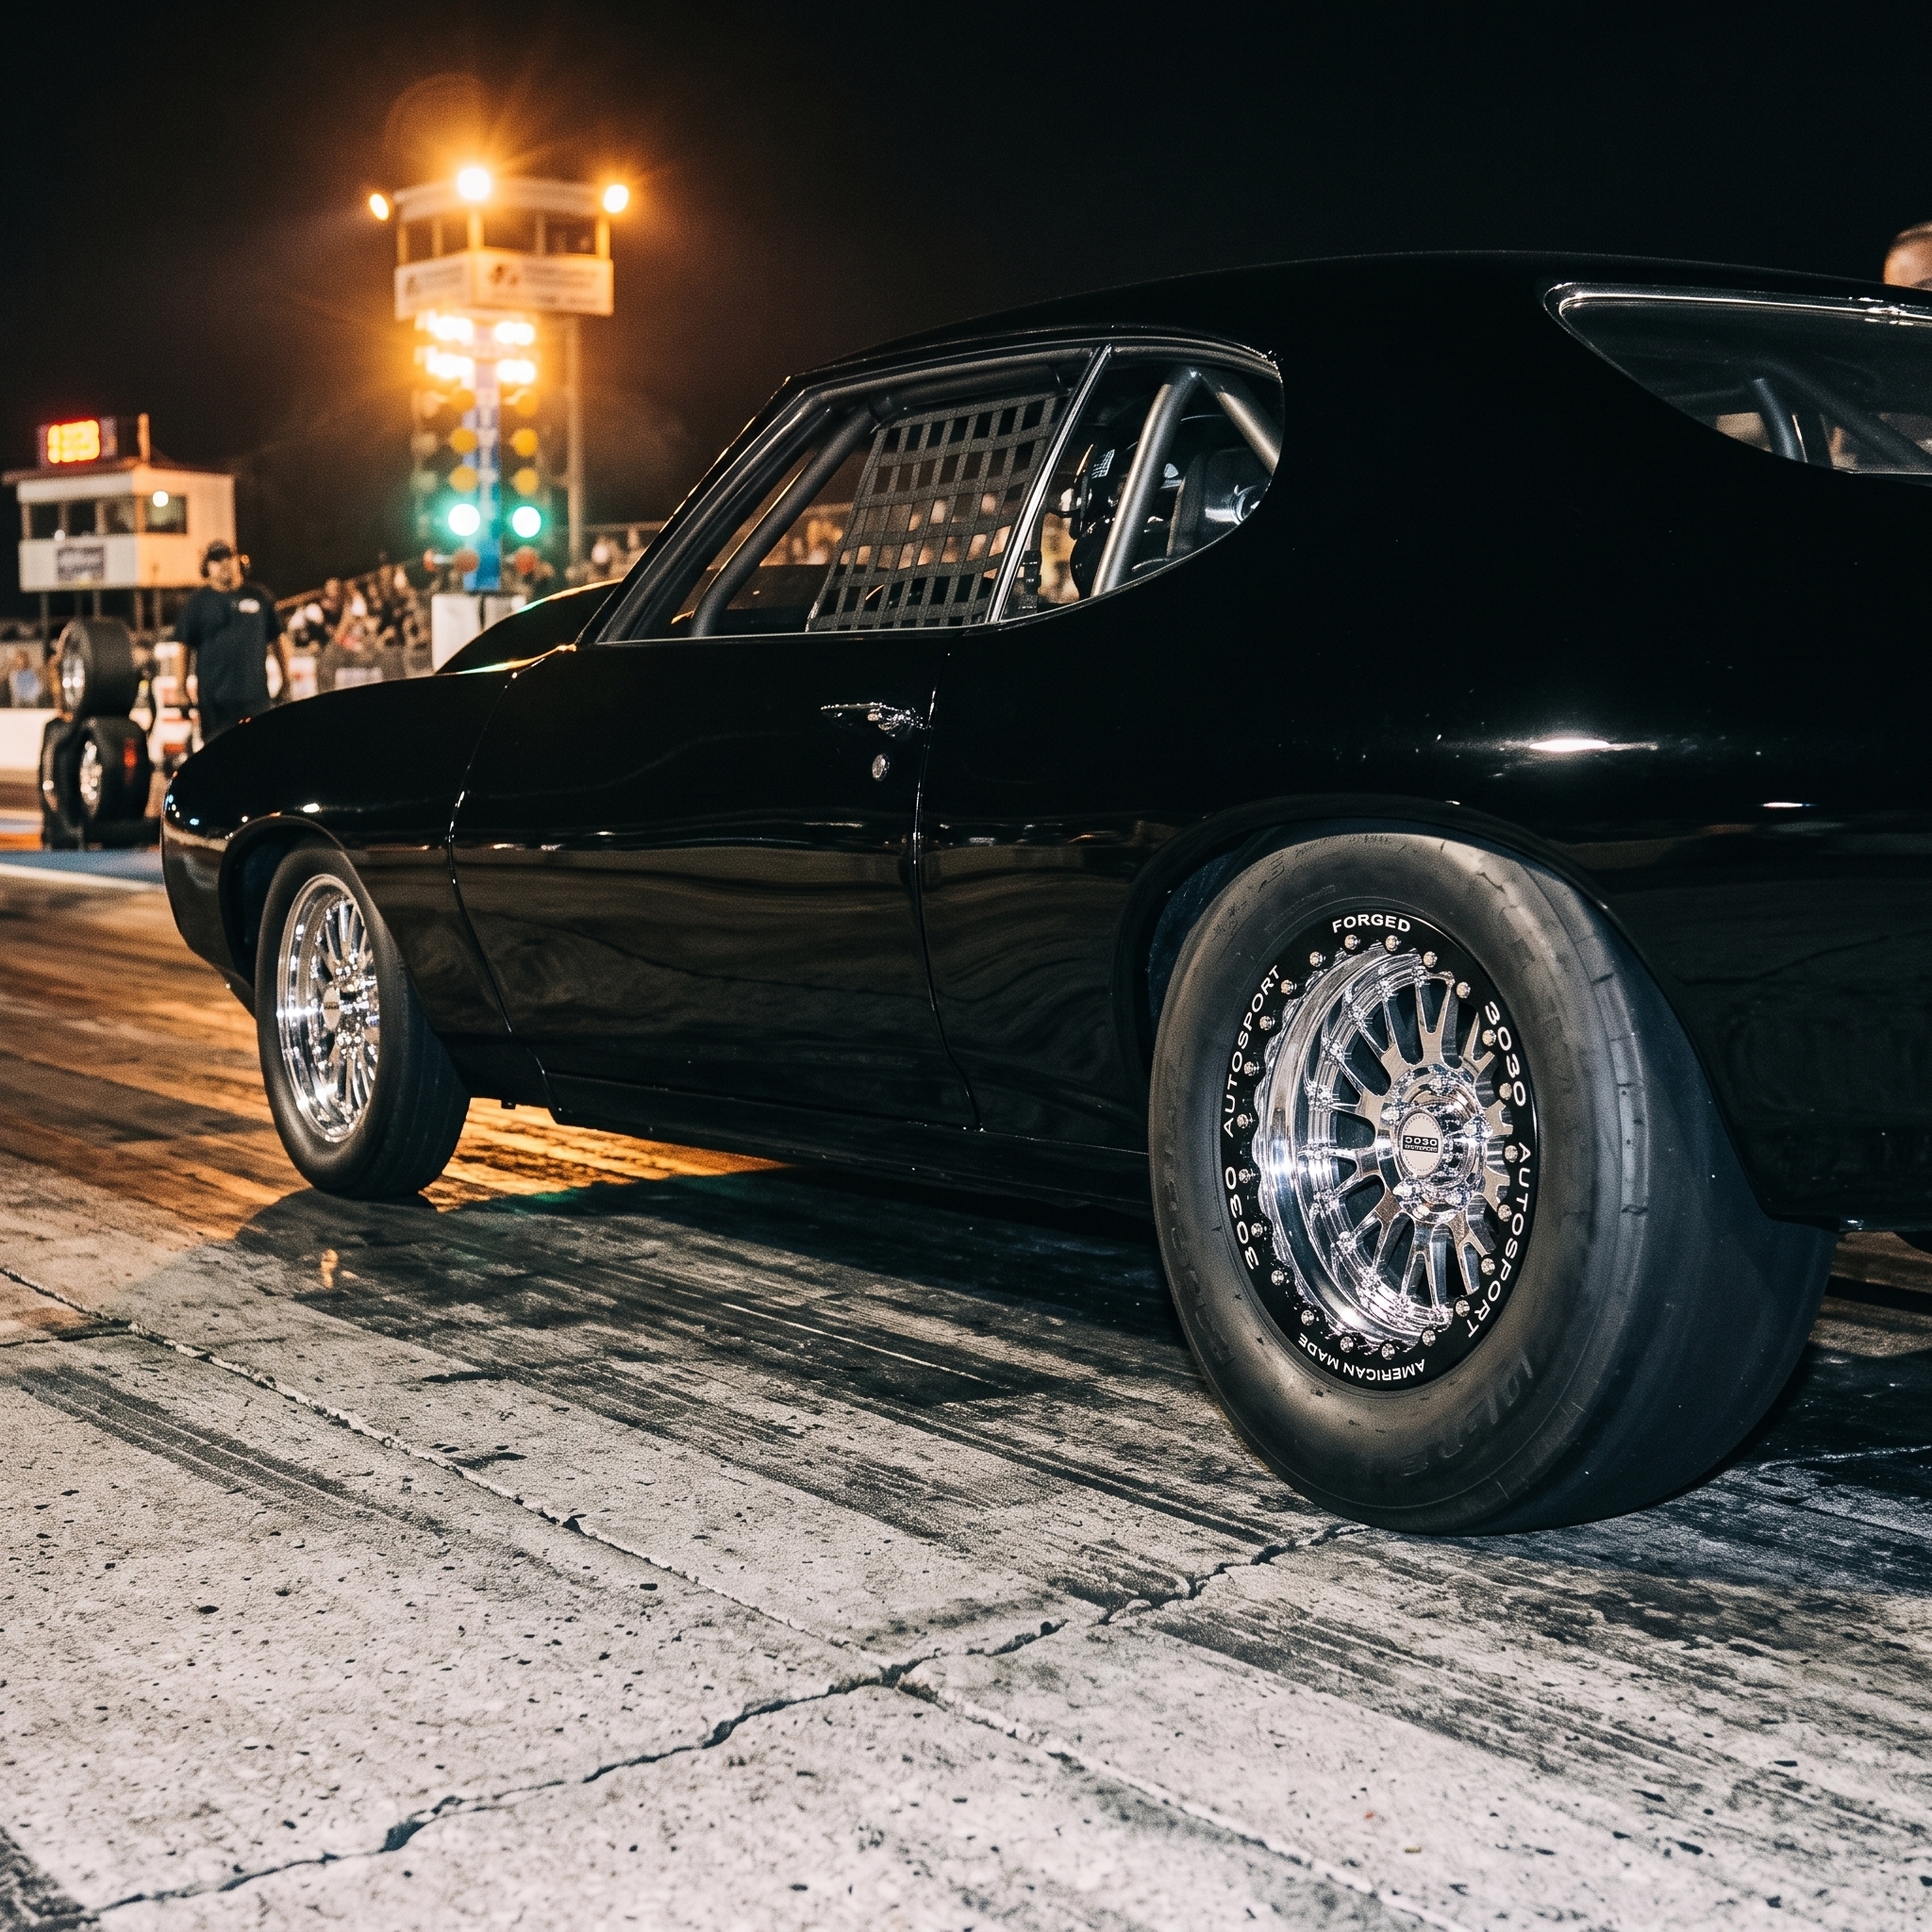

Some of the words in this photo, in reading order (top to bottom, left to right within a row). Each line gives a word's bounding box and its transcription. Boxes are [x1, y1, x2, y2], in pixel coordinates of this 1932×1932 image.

[1331, 913, 1411, 934] FORGED
[1223, 964, 1280, 1138] AUTOSPORT
[1485, 1001, 1526, 1107] 3030
[1224, 1166, 1259, 1270] 3030
[1468, 1141, 1532, 1338] AUTOSPORT
[1297, 1333, 1340, 1371] MADE
[1342, 1358, 1425, 1381] AMERICAN
